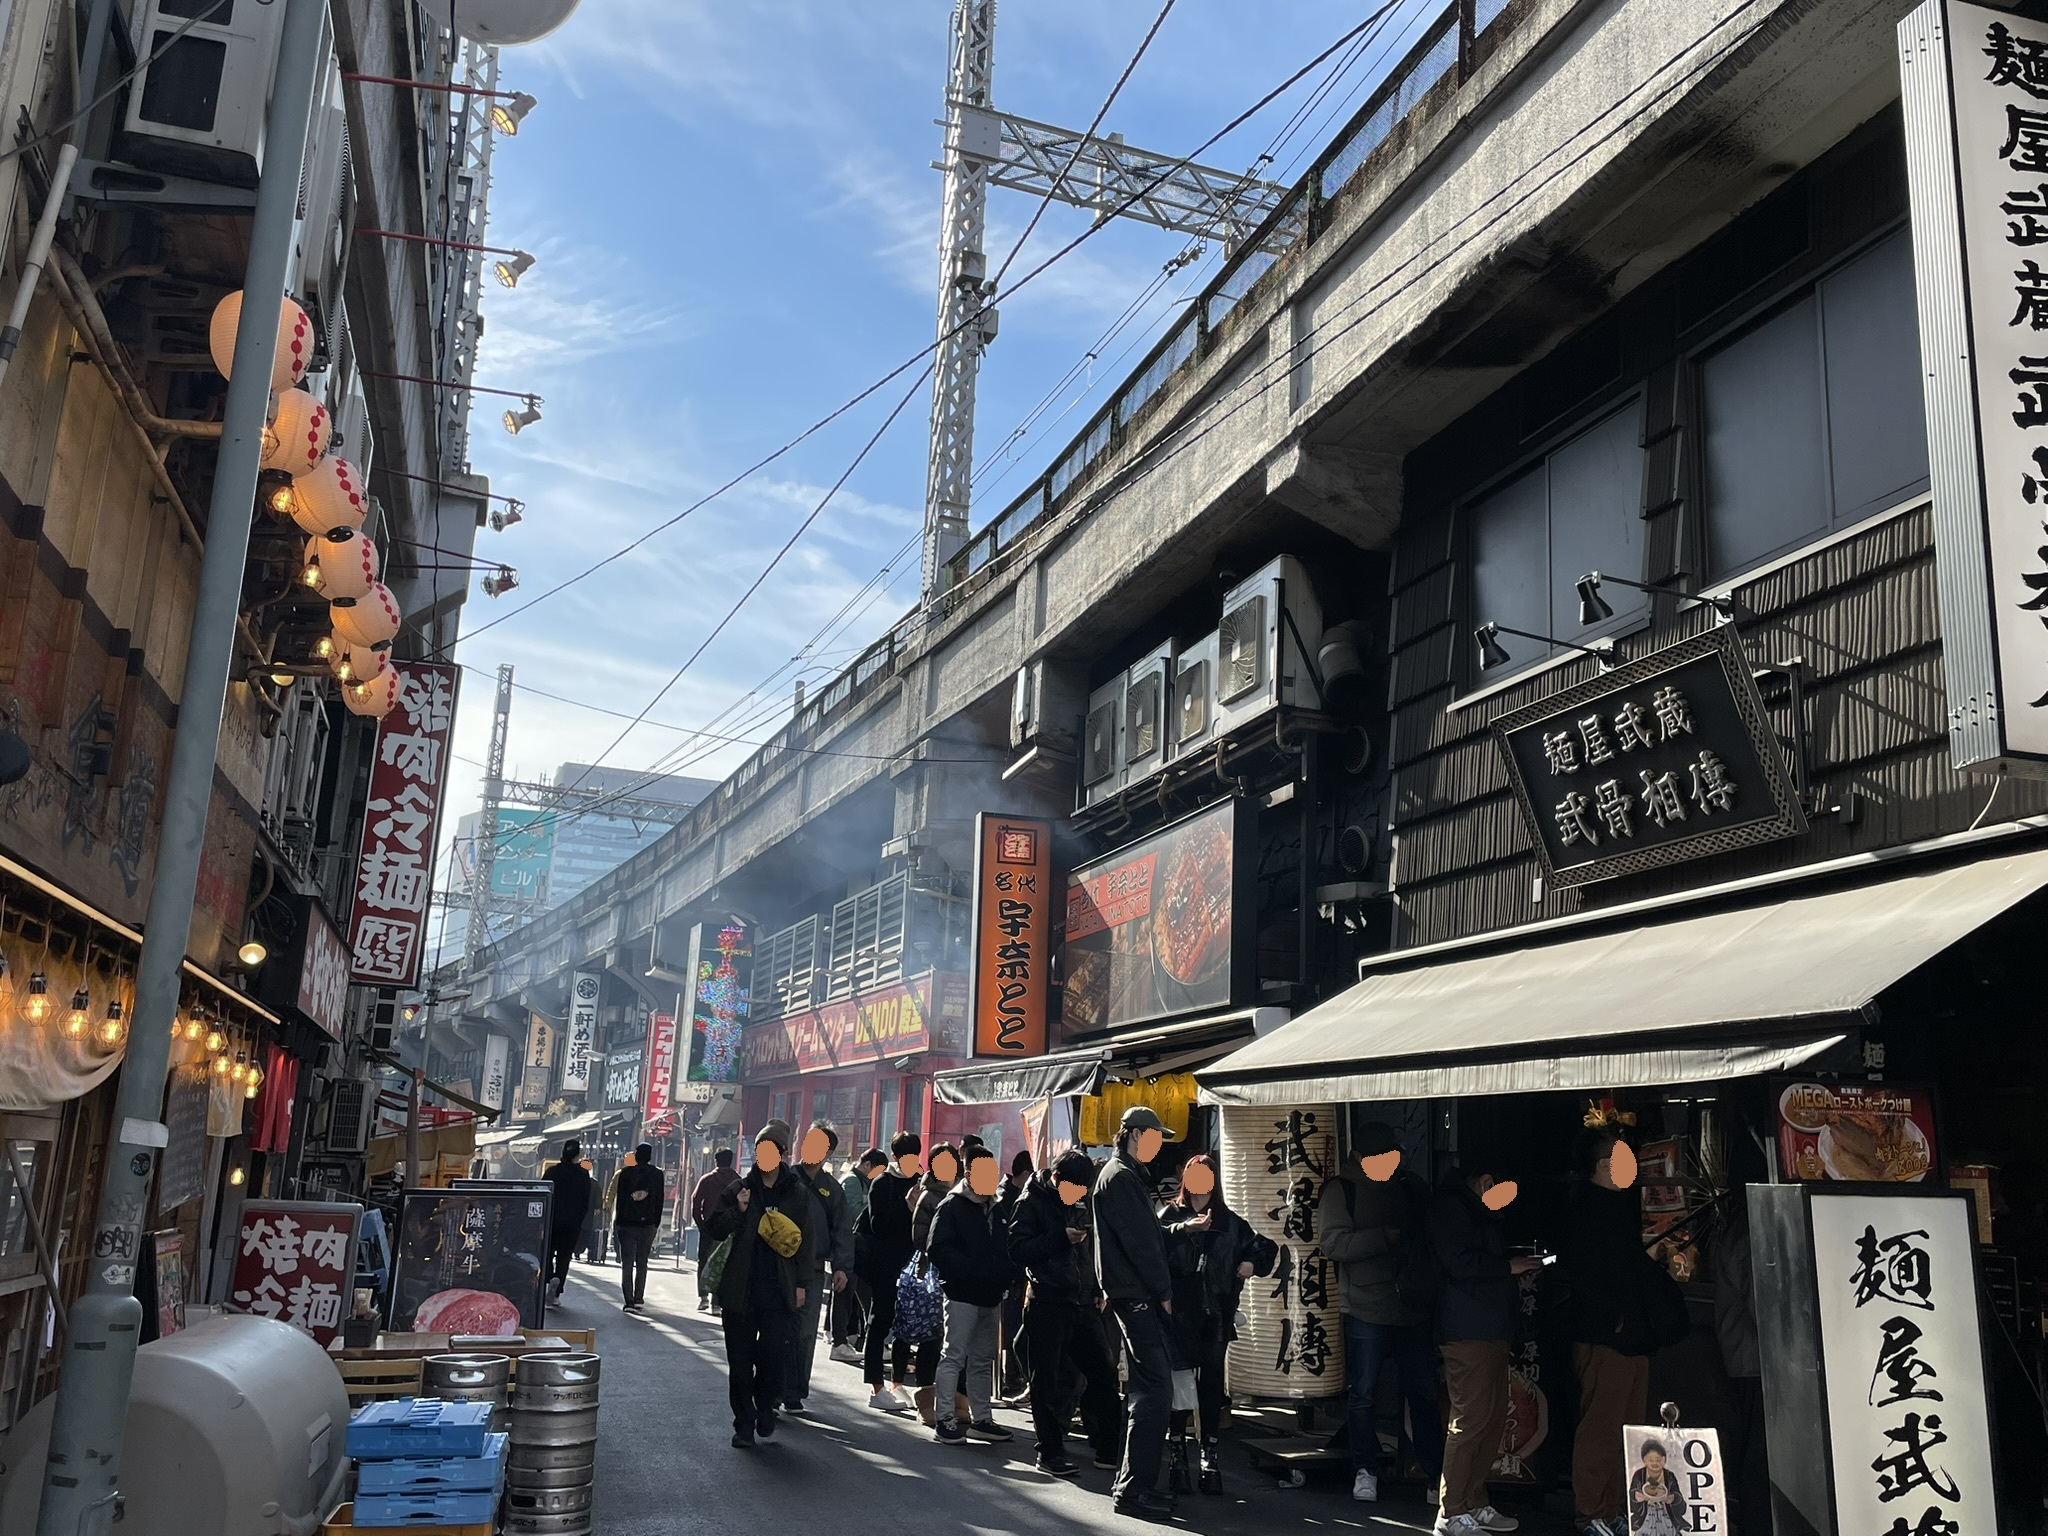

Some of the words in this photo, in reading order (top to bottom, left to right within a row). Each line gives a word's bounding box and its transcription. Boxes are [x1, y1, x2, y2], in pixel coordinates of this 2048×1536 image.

[1542, 685, 1696, 777] 麺屋武蔵
[358, 671, 453, 914] 焼肉冷麺
[1554, 748, 1738, 848] 武骨相傳
[501, 870, 532, 886] ビル
[994, 899, 1034, 1051] 宇奈とと
[567, 1003, 595, 1081] 一軒め酒場
[855, 999, 898, 1048] DENDO
[242, 1214, 348, 1277] 焼肉
[460, 1207, 486, 1276] 薩摩牛
